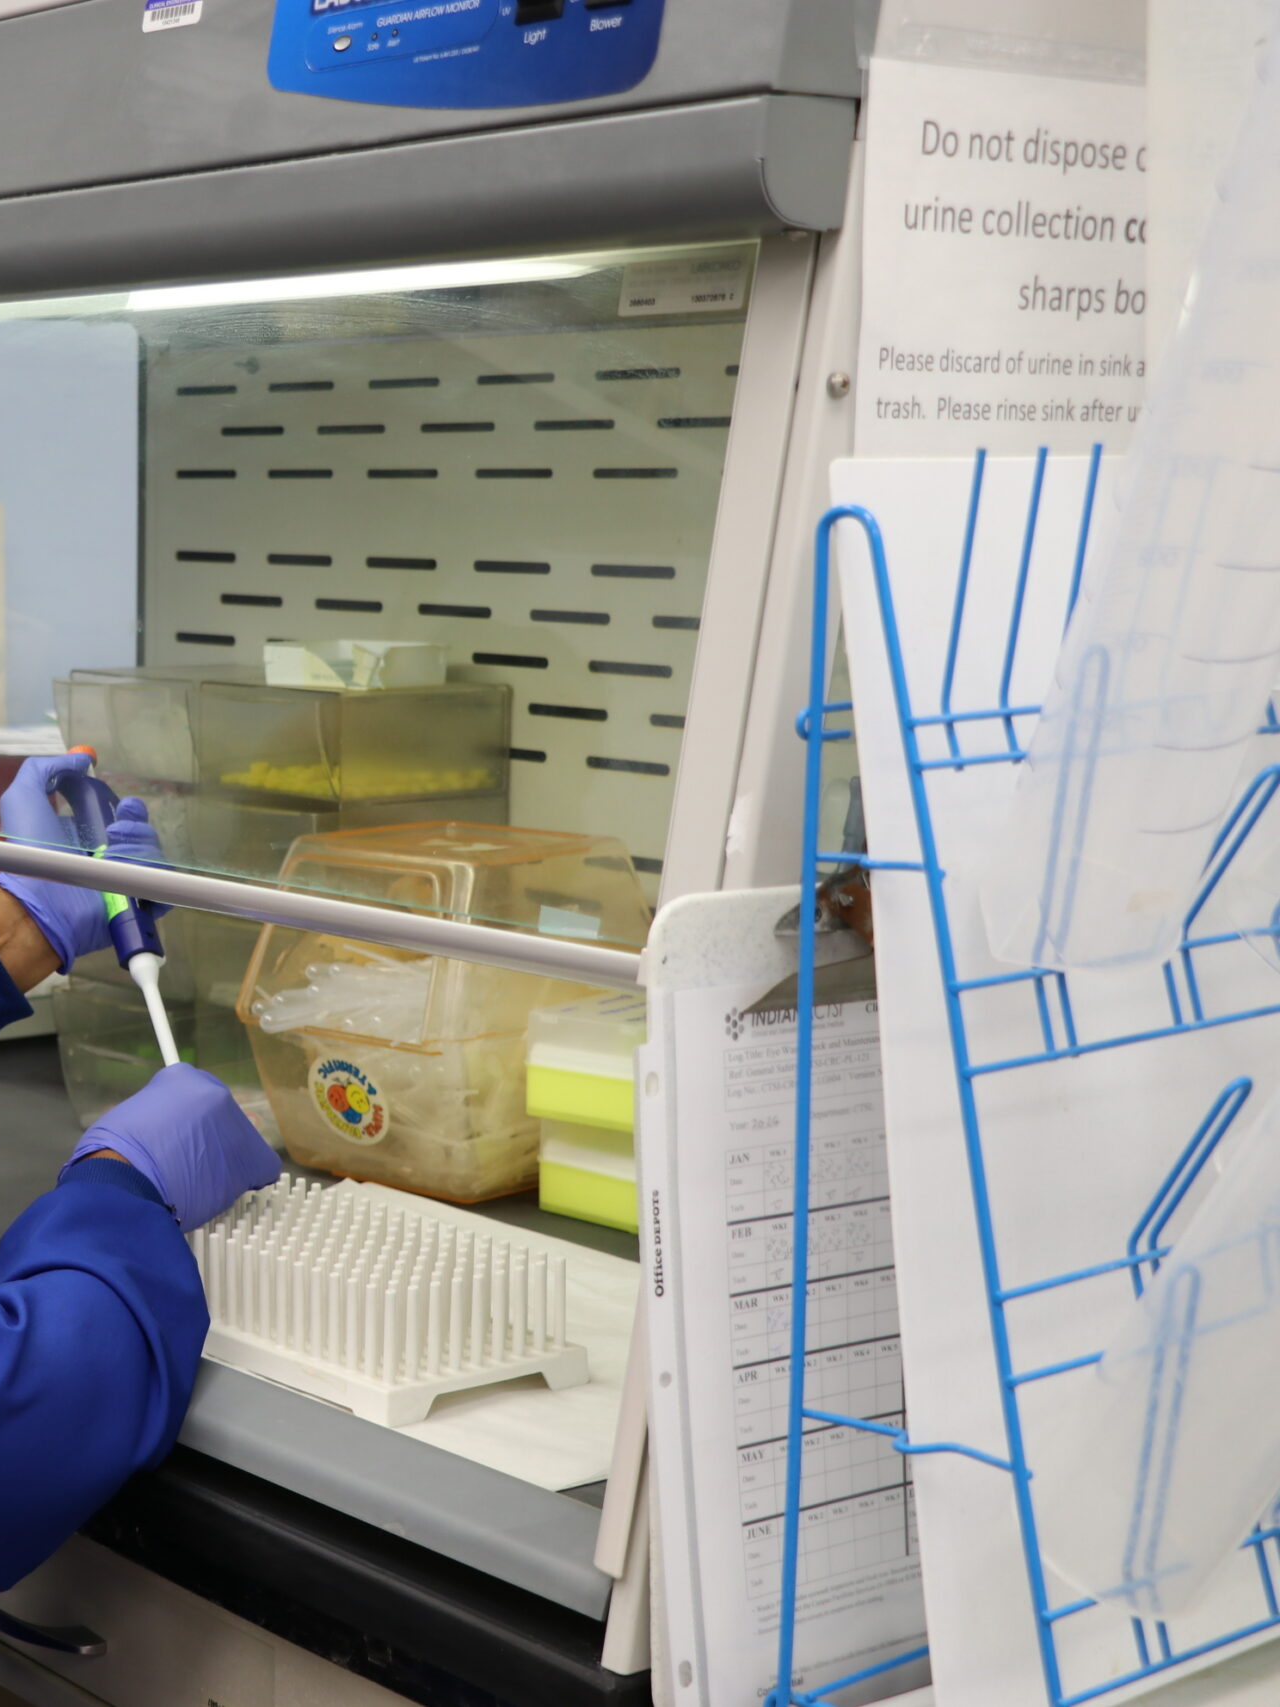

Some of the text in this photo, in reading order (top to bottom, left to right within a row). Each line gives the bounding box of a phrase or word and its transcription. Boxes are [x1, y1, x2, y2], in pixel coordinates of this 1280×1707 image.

[376, 0, 480, 28] GUARDIAN AIRFLOW MONITOR
[589, 16, 623, 32] Blower
[523, 28, 547, 46] Light
[921, 119, 959, 158] Do
[969, 129, 1015, 163] not
[1022, 126, 1127, 176] dispose
[903, 196, 973, 235] urine
[982, 199, 1115, 242] collection
[1018, 274, 1106, 321] sharps
[878, 345, 935, 372] Please
[939, 347, 1001, 375] discard
[1005, 350, 1024, 375] of
[1027, 352, 1072, 376] urine
[1078, 353, 1094, 376] in
[1098, 353, 1132, 377] sink
[876, 395, 926, 420] trash.
[936, 396, 991, 421] Please
[996, 398, 1037, 421] rinse
[1041, 398, 1075, 422] sink
[1080, 398, 1122, 423] after
[729, 1153, 751, 1165] JAN
[731, 1227, 752, 1239] FEB
[653, 1248, 664, 1297] Office
[734, 1298, 758, 1310] MAR
[737, 1371, 758, 1384] APR
[741, 1450, 765, 1464] MAY
[746, 1525, 771, 1540] JUNE
